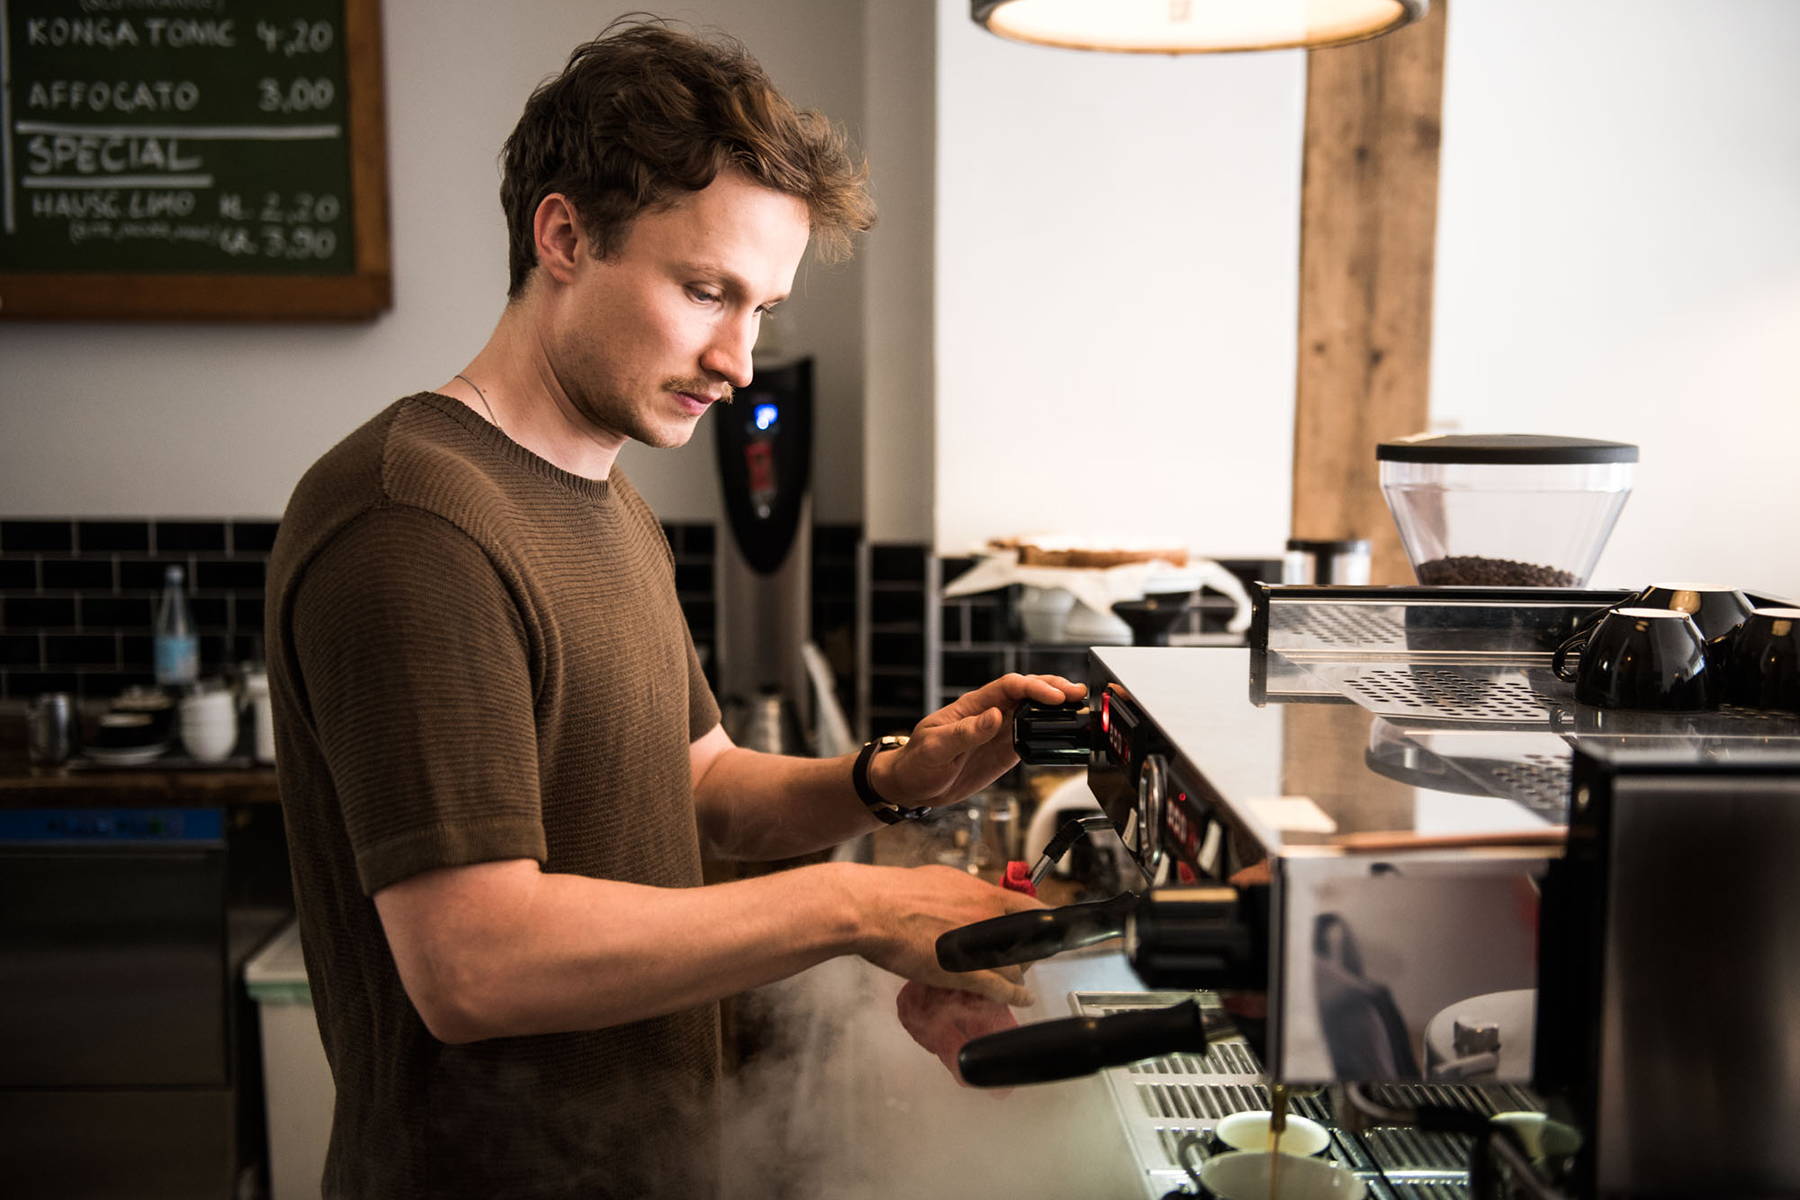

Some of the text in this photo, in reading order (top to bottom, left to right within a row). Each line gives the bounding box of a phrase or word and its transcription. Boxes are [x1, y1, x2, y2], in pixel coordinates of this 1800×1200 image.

[28, 18, 138, 47] KONGA
[145, 18, 236, 47] TONIC
[29, 81, 200, 111] AFFOCATO
[28, 136, 203, 173] SPECIAL
